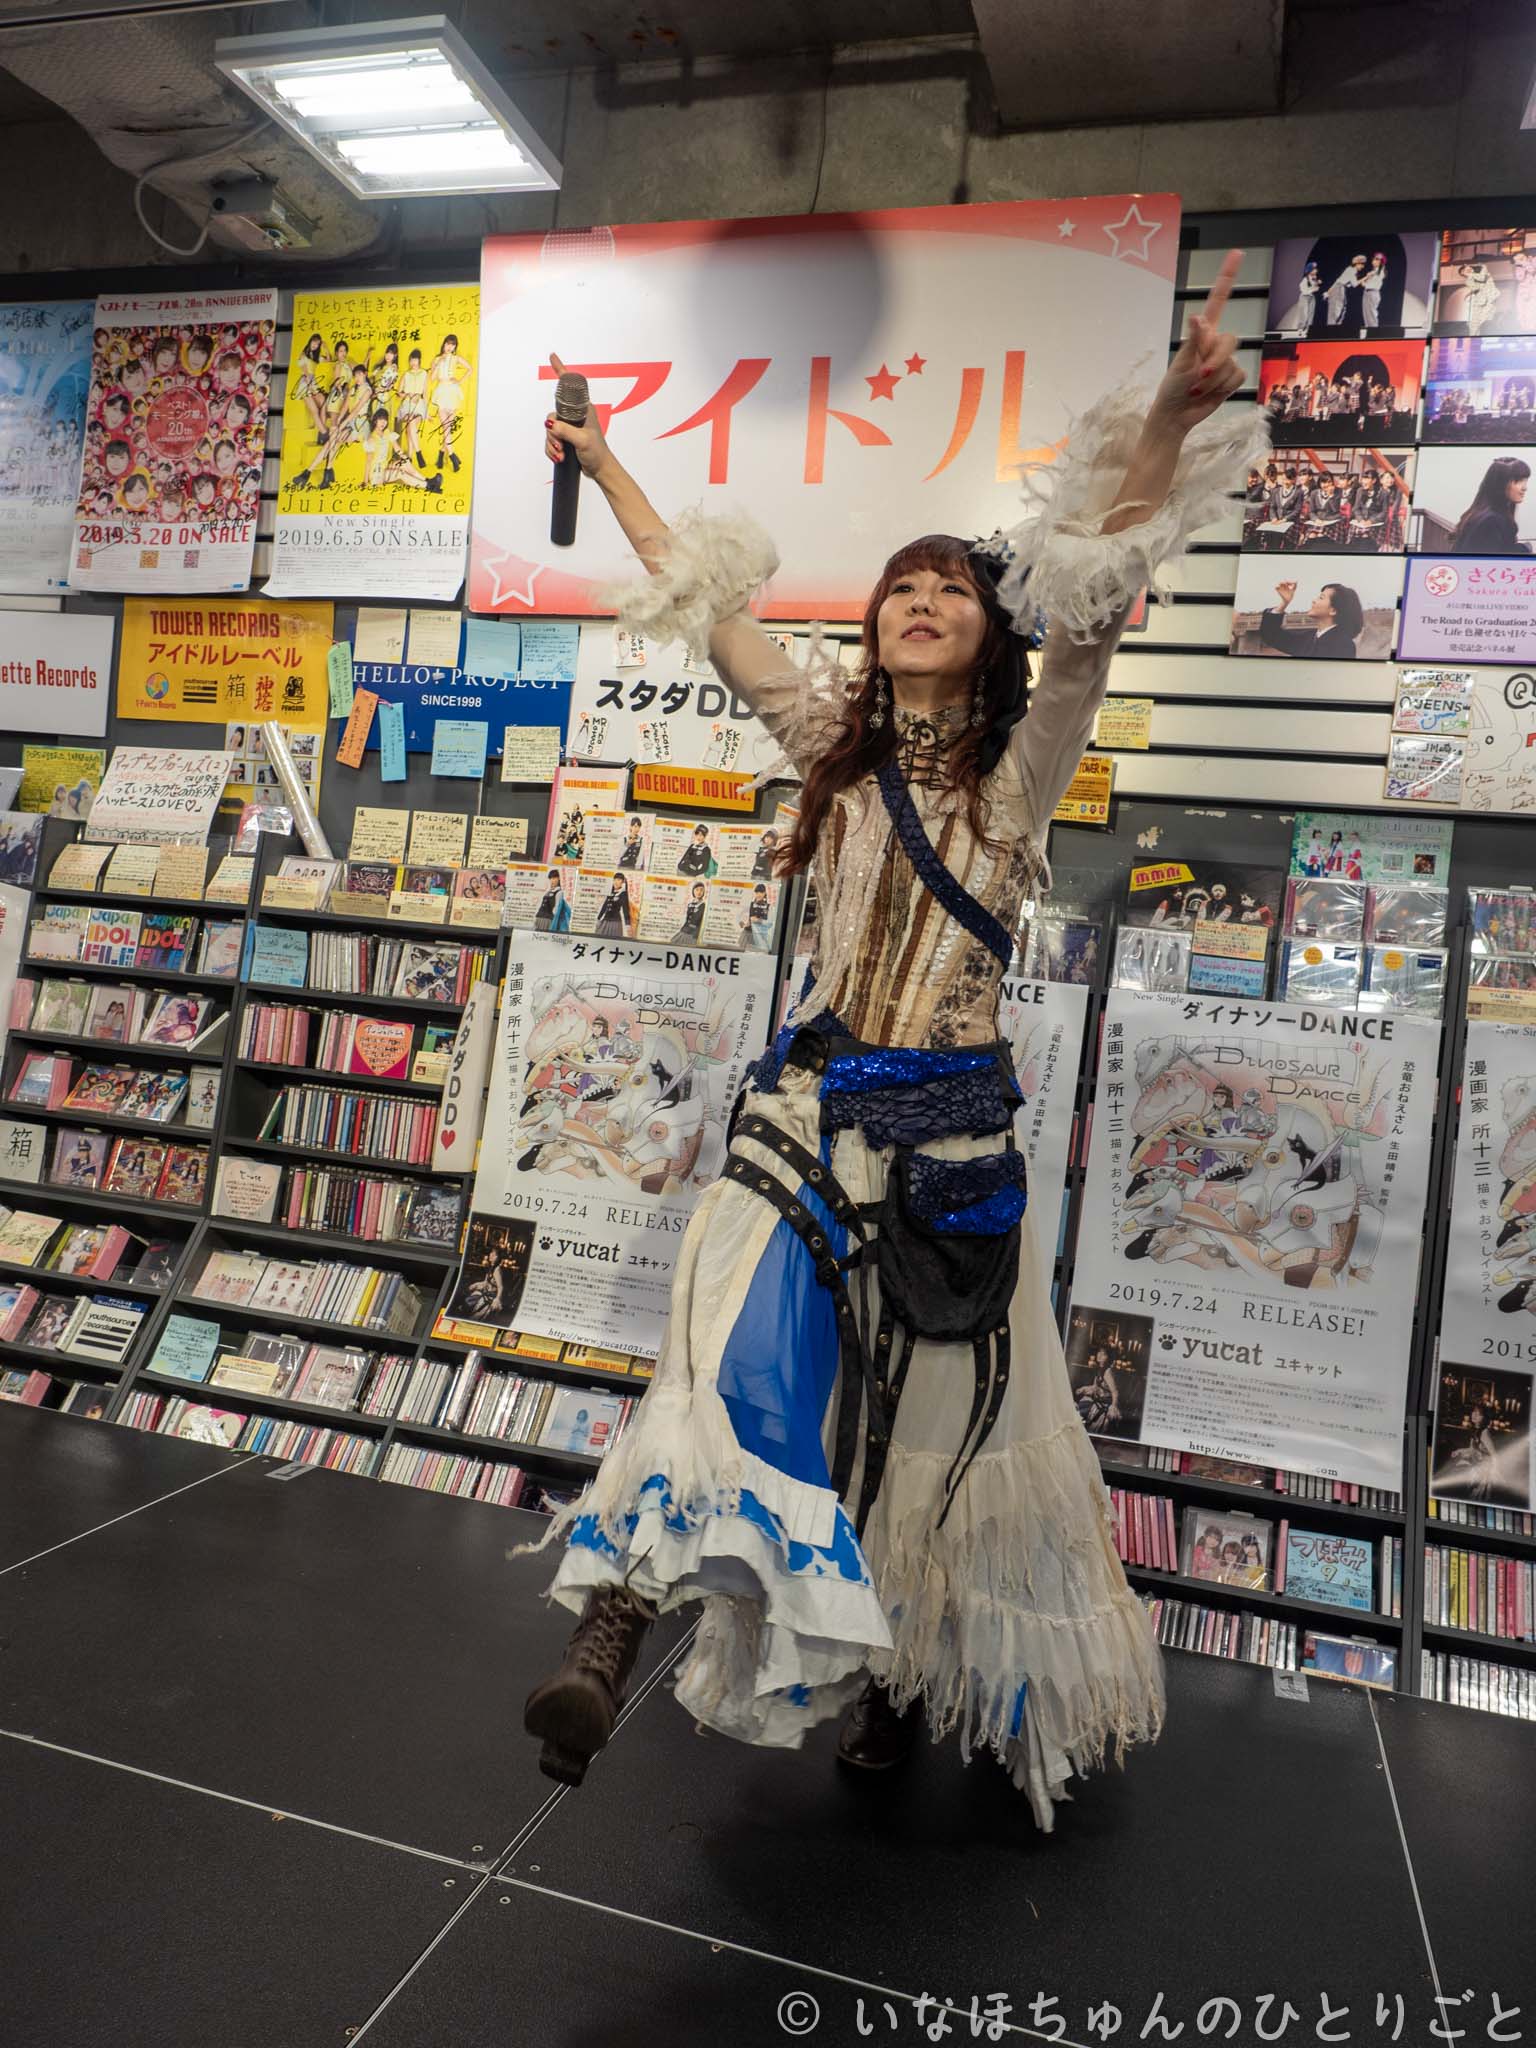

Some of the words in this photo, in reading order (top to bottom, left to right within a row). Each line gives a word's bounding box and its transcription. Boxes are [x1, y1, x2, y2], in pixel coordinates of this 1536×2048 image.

[204, 293, 272, 308] ANNIVERSARY
[538, 350, 1070, 486] アイドル
[78, 524, 173, 546] 2019.3.20
[179, 526, 203, 545] ON
[208, 524, 251, 544] SALE
[323, 515, 354, 528] New
[361, 515, 416, 530] Single
[278, 528, 364, 547] 2019.6.5
[372, 529, 402, 547] ON
[408, 529, 463, 547] SALE
[1468, 586, 1508, 597] Sakura
[150, 610, 204, 636] TOWER
[208, 611, 281, 638] RECORDS
[1420, 615, 1438, 625] The
[1439, 616, 1462, 626] Road
[1464, 617, 1473, 626] to
[1475, 617, 1528, 628] Graduation
[1444, 627, 1464, 637] Life
[148, 642, 303, 669] アイドルレーベル
[0, 660, 31, 685] ette
[36, 659, 97, 689] Records
[226, 674, 246, 698] 箱
[421, 694, 482, 708] SINCE1998
[596, 679, 758, 721] スタダDD
[637, 772, 653, 792] NO
[654, 774, 700, 797] EBICHU.
[702, 778, 720, 799] NO
[91, 909, 140, 925] Japan
[146, 913, 192, 929] Japan
[87, 923, 137, 946] IDOL
[140, 928, 186, 949] IDOL
[532, 932, 551, 943] New
[551, 933, 573, 946] Single
[84, 943, 135, 968] FILE
[134, 946, 185, 970] FILE
[572, 942, 742, 977] ダイナソーDANCE
[508, 961, 525, 1007] 漫画家
[1133, 991, 1155, 1002] New
[1156, 992, 1185, 1005] Single
[1183, 1000, 1394, 1041] ダイナソーDANCE
[505, 1015, 522, 1061] 所十三
[1105, 1022, 1125, 1074] 漫画家
[444, 1000, 476, 1127] スタダDD
[1390, 1060, 1417, 1136] 恐竜おねえさん
[1469, 1059, 1489, 1115] 漫画家
[1105, 1081, 1125, 1134] 所十三
[7, 1127, 33, 1158] 箱
[1472, 1122, 1493, 1178] 所十三
[1383, 1141, 1401, 1183] 生田晴香
[1109, 1137, 1123, 1255] 描きおろしイラスト
[503, 1192, 588, 1219] 2019.7.24
[606, 1206, 692, 1233] RELEAS
[556, 1237, 621, 1264] yucat
[628, 1254, 670, 1271] ユキャッ
[1475, 1182, 1494, 1307] 描きおろしイラスト
[87, 1312, 132, 1327] youthsource
[1109, 1283, 1218, 1315] 2019.7.24
[1242, 1300, 1367, 1337] RELEASE!
[1158, 1320, 1218, 1335] シンガーソングライター
[1182, 1337, 1264, 1366] yucat
[1274, 1356, 1343, 1379] ユキャット
[1289, 1534, 1368, 1571] つぼみ
